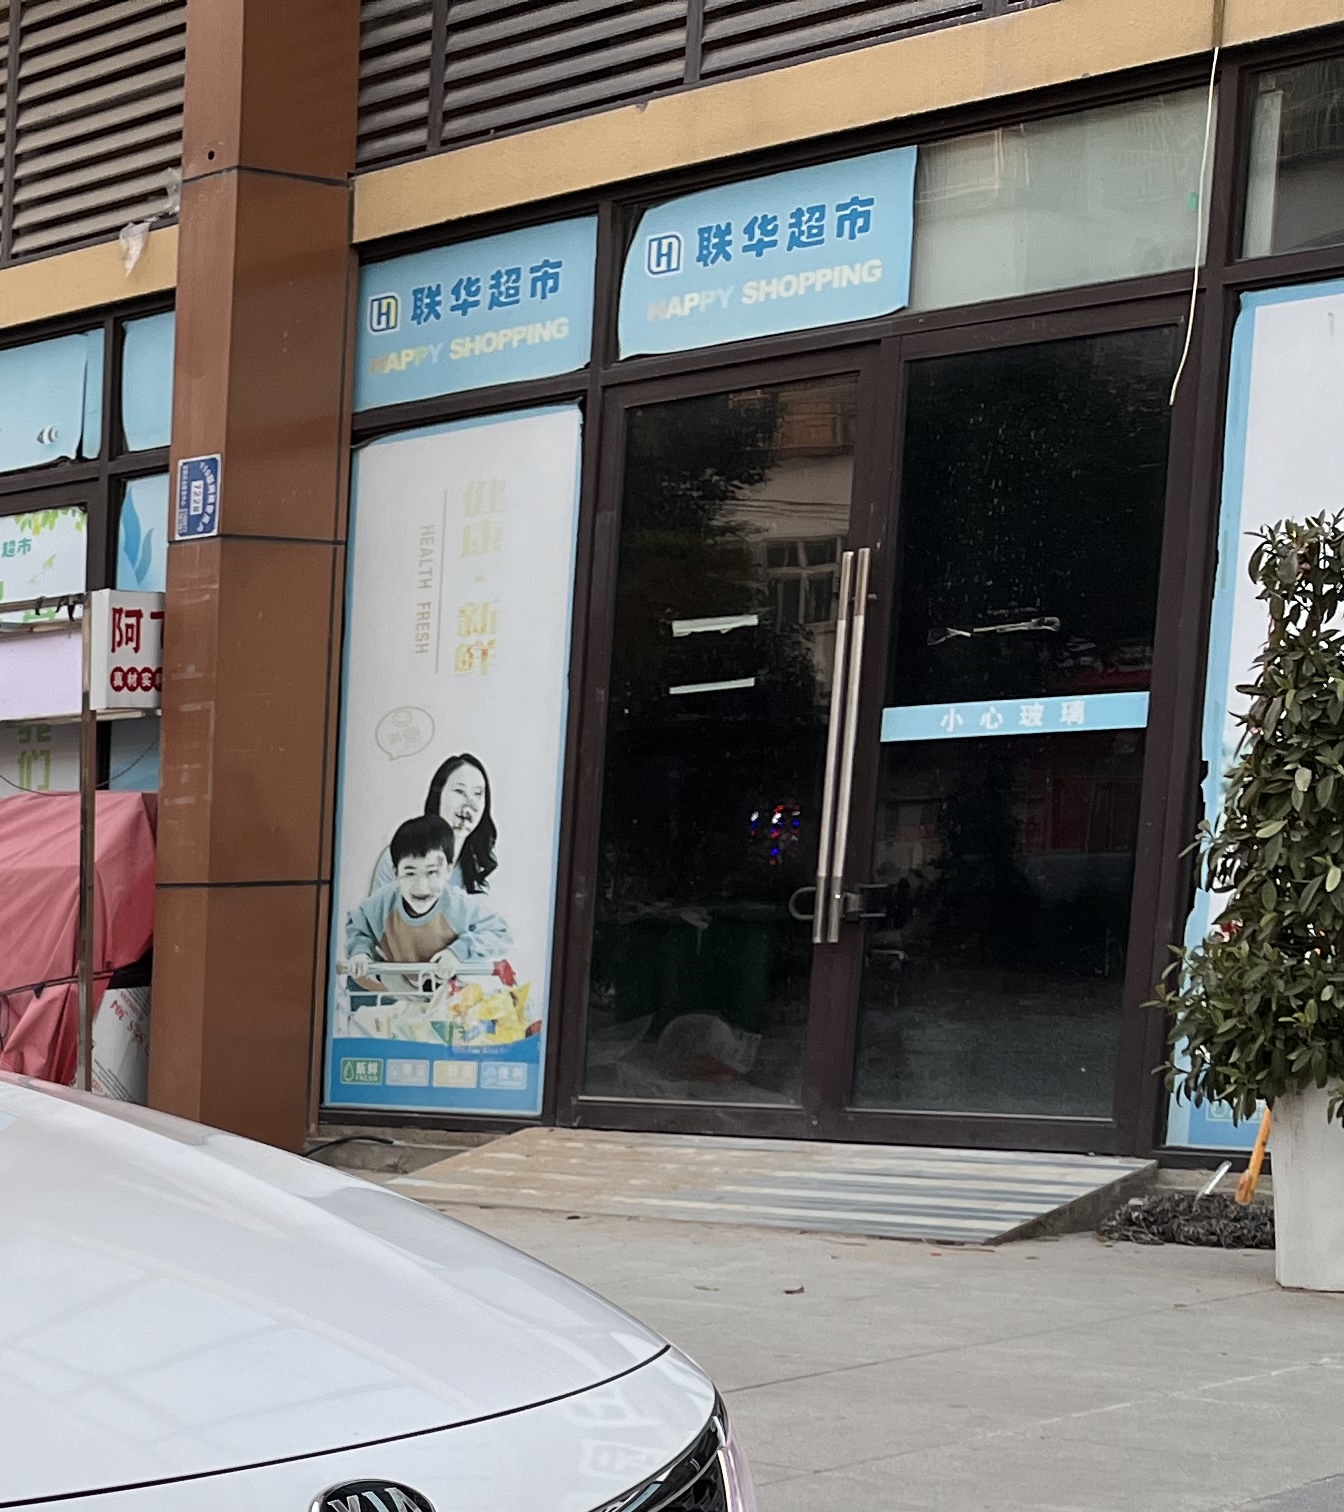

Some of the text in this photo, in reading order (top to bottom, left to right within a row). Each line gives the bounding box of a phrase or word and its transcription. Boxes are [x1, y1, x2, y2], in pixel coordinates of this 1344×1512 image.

[696, 195, 875, 267] 联华超市
[411, 259, 563, 325] 联华超市
[648, 259, 883, 321] HAPPY SHOPPING
[370, 317, 570, 376] HAPPY SHOPPING
[415, 524, 435, 655] HEALTH FRESH
[112, 669, 162, 689] 真材实
[940, 699, 1085, 732] 小心玻璃
